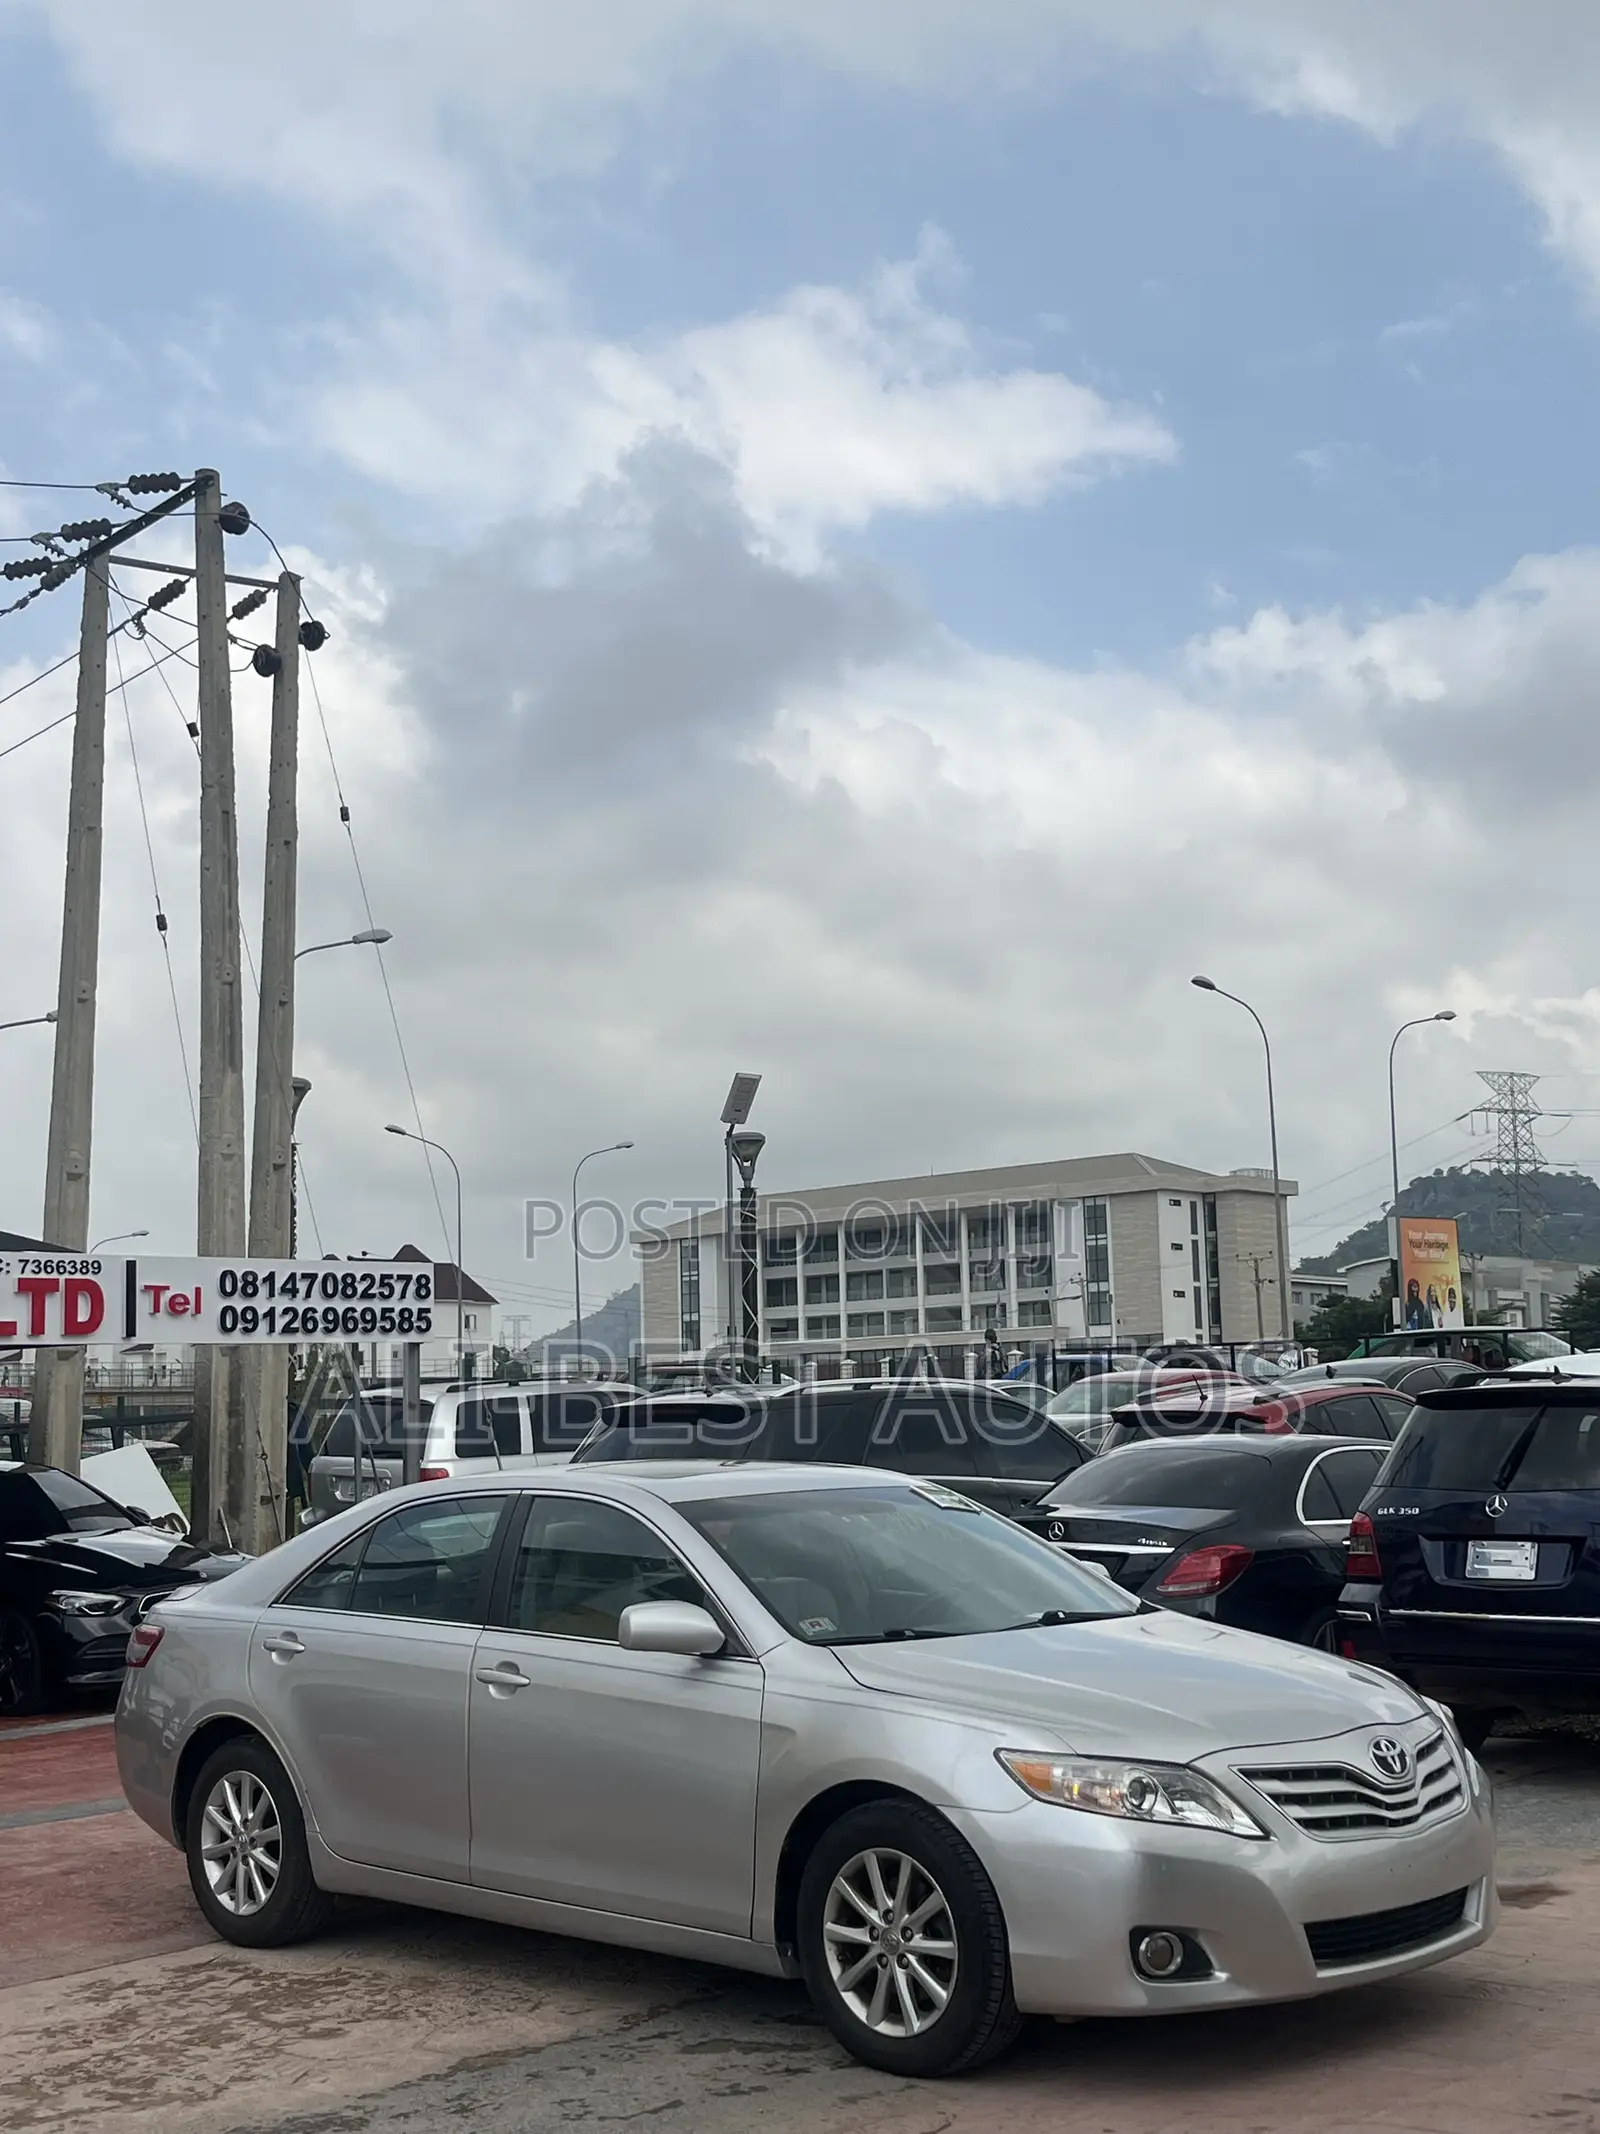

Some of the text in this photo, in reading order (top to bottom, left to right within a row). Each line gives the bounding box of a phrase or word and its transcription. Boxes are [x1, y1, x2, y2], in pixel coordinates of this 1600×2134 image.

[18, 1258, 103, 1275] 7366389
[218, 1269, 432, 1300] 08147082578
[143, 1284, 202, 1316] Tel
[219, 1304, 432, 1334] 09126969585
[1377, 1506, 1420, 1515] GLK 350
